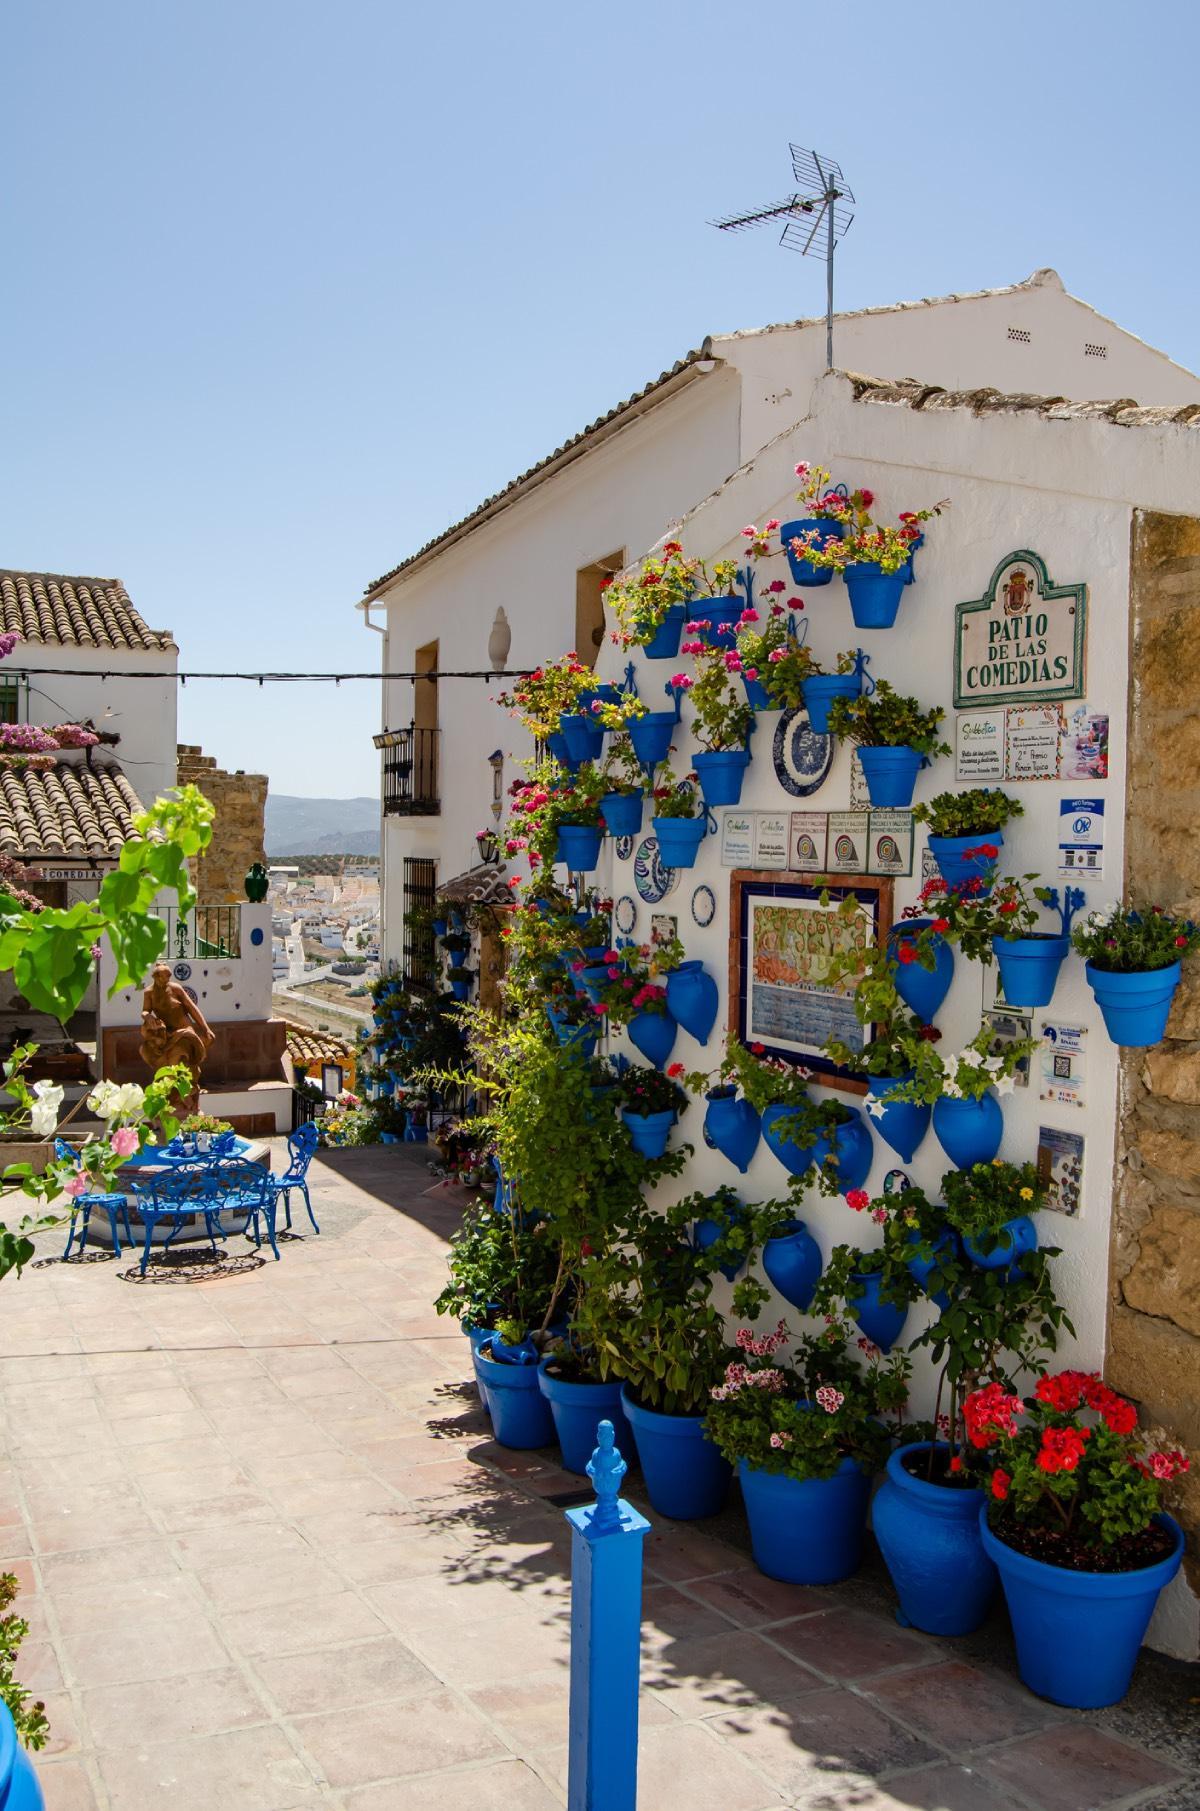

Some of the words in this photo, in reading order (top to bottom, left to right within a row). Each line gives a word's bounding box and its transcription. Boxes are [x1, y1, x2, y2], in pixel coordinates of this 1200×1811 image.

[988, 613, 1048, 643] PATIO
[988, 645, 1009, 661] DE
[1015, 639, 1047, 658] LAS
[967, 656, 1068, 688] COMEDIAS
[49, 870, 104, 879] COMEDIAS
